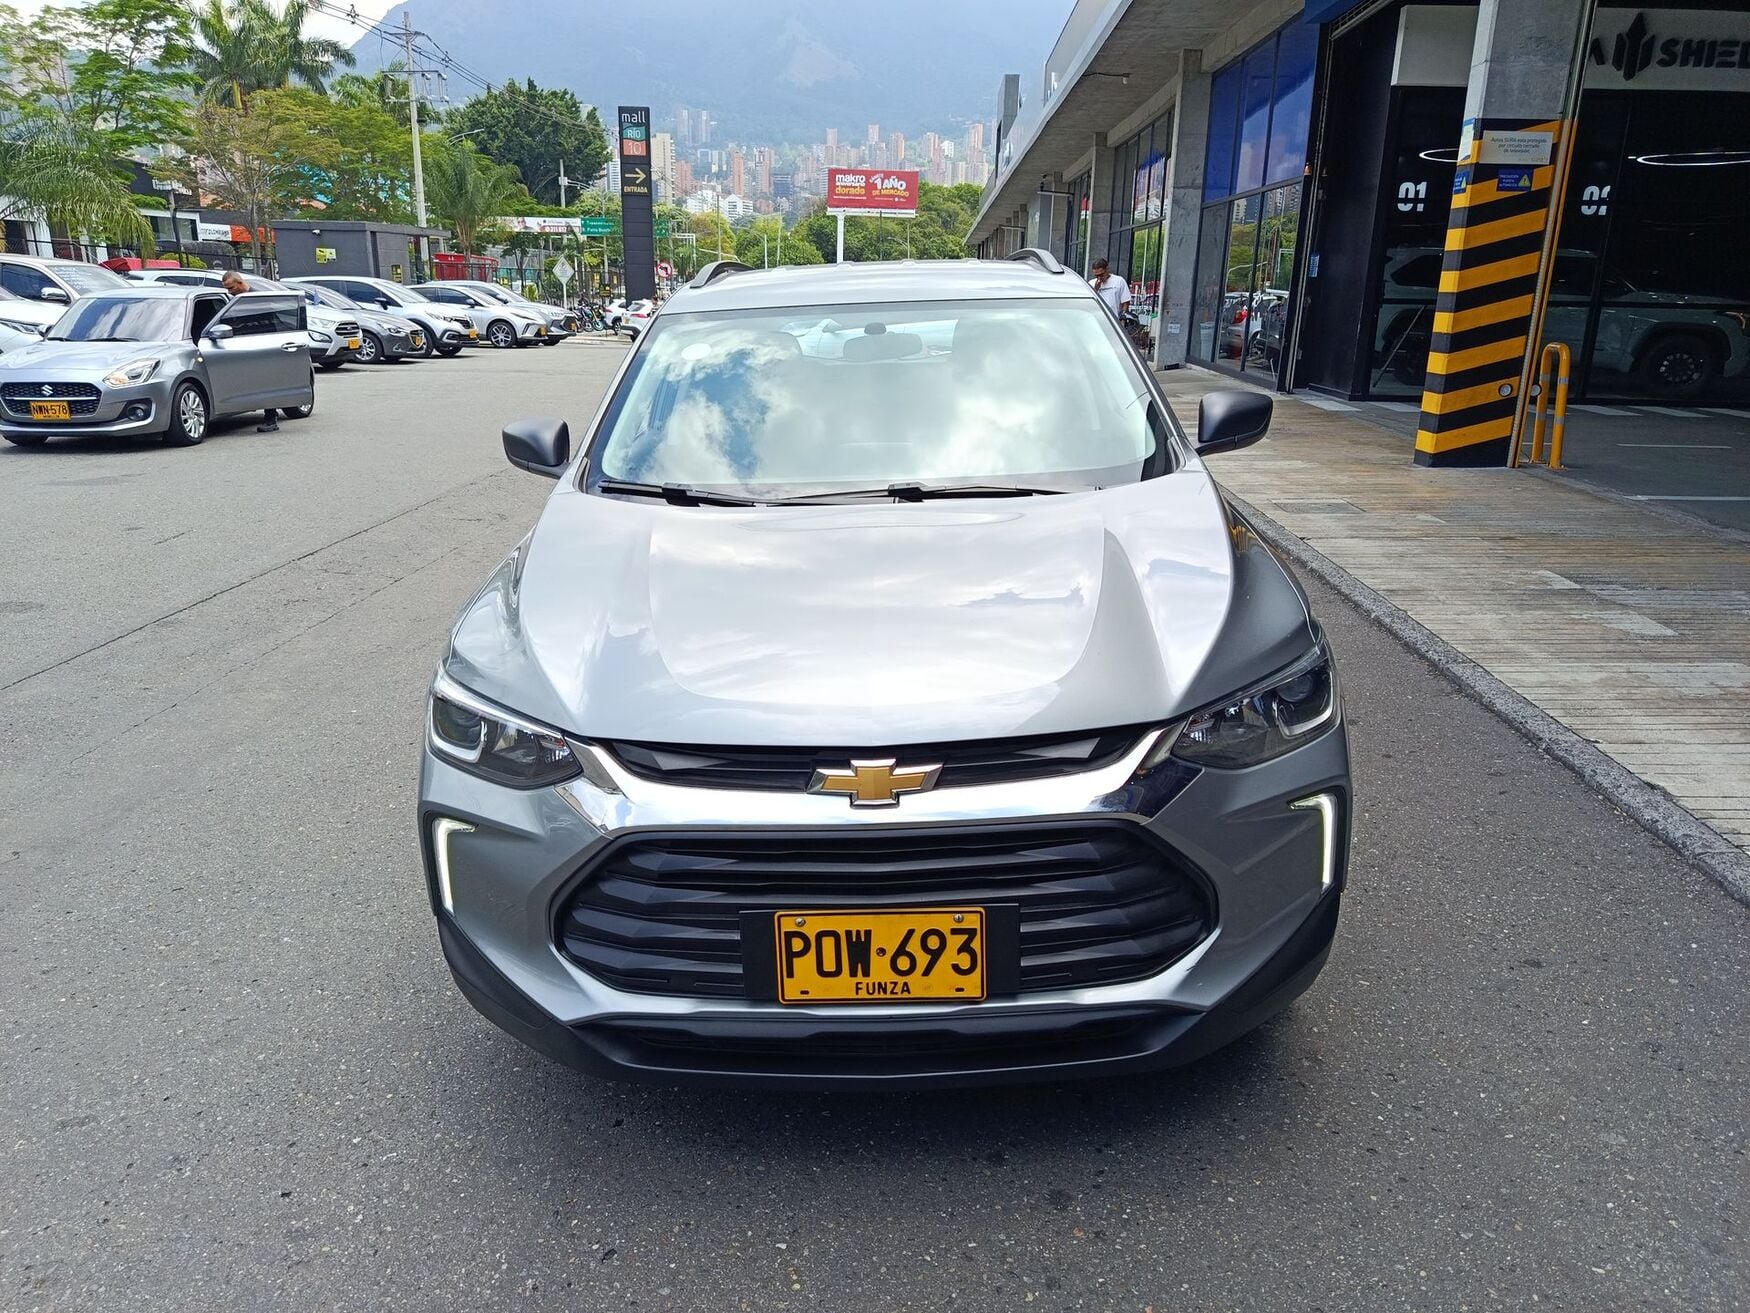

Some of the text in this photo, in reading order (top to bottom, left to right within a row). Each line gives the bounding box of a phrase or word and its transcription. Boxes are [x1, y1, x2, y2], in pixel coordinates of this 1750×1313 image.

[622, 111, 646, 123] mall
[628, 142, 641, 155] 10
[836, 173, 866, 184] makro
[874, 175, 907, 190] 1 AÑO
[836, 186, 866, 195] dorado
[881, 188, 910, 197] MERCADO
[1397, 181, 1427, 212] 01
[855, 981, 911, 996] FUNZA
